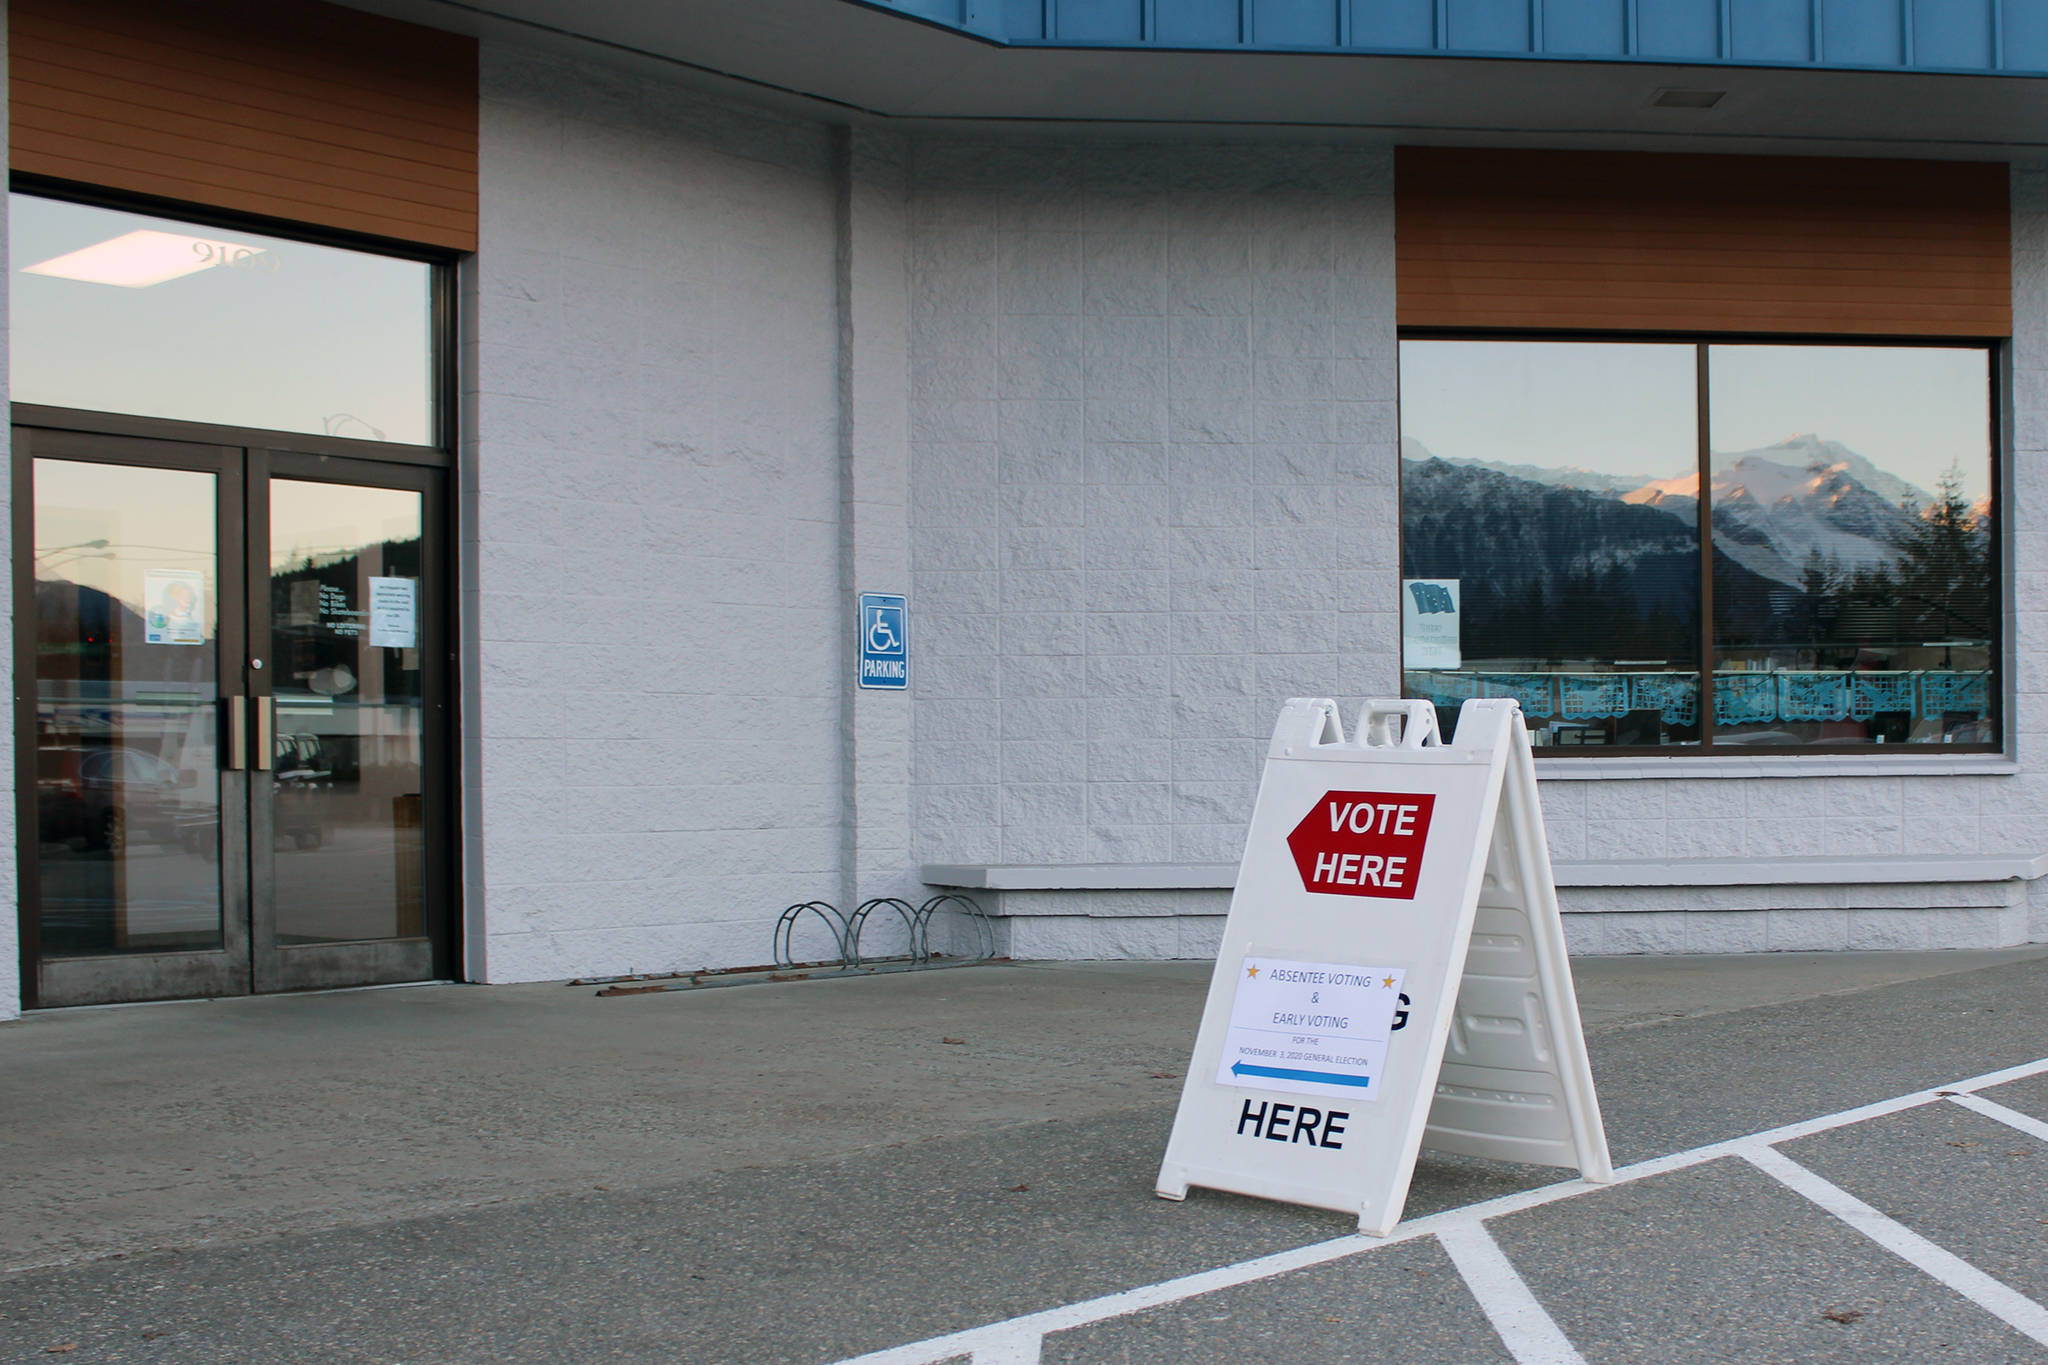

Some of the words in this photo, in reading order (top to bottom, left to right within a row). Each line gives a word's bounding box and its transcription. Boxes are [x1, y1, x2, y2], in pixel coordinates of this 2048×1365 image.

[863, 659, 905, 679] PARKING
[1329, 802, 1419, 836] VOTE
[1312, 852, 1408, 888] HERE
[1269, 969, 1326, 985] ABSENTEE
[1327, 973, 1372, 988] VOTING
[1311, 991, 1320, 1004] &
[1272, 1012, 1306, 1026] EARLY
[1307, 1015, 1349, 1029] VOTING
[1292, 1036, 1304, 1045] FOR
[1305, 1037, 1319, 1046] THE
[1239, 1047, 1277, 1058] NOVEMBER
[1286, 1051, 1303, 1060] 2020
[1303, 1052, 1334, 1063] GENERAL
[1335, 1055, 1368, 1066] ELECTION
[1237, 1098, 1350, 1149] HERE
